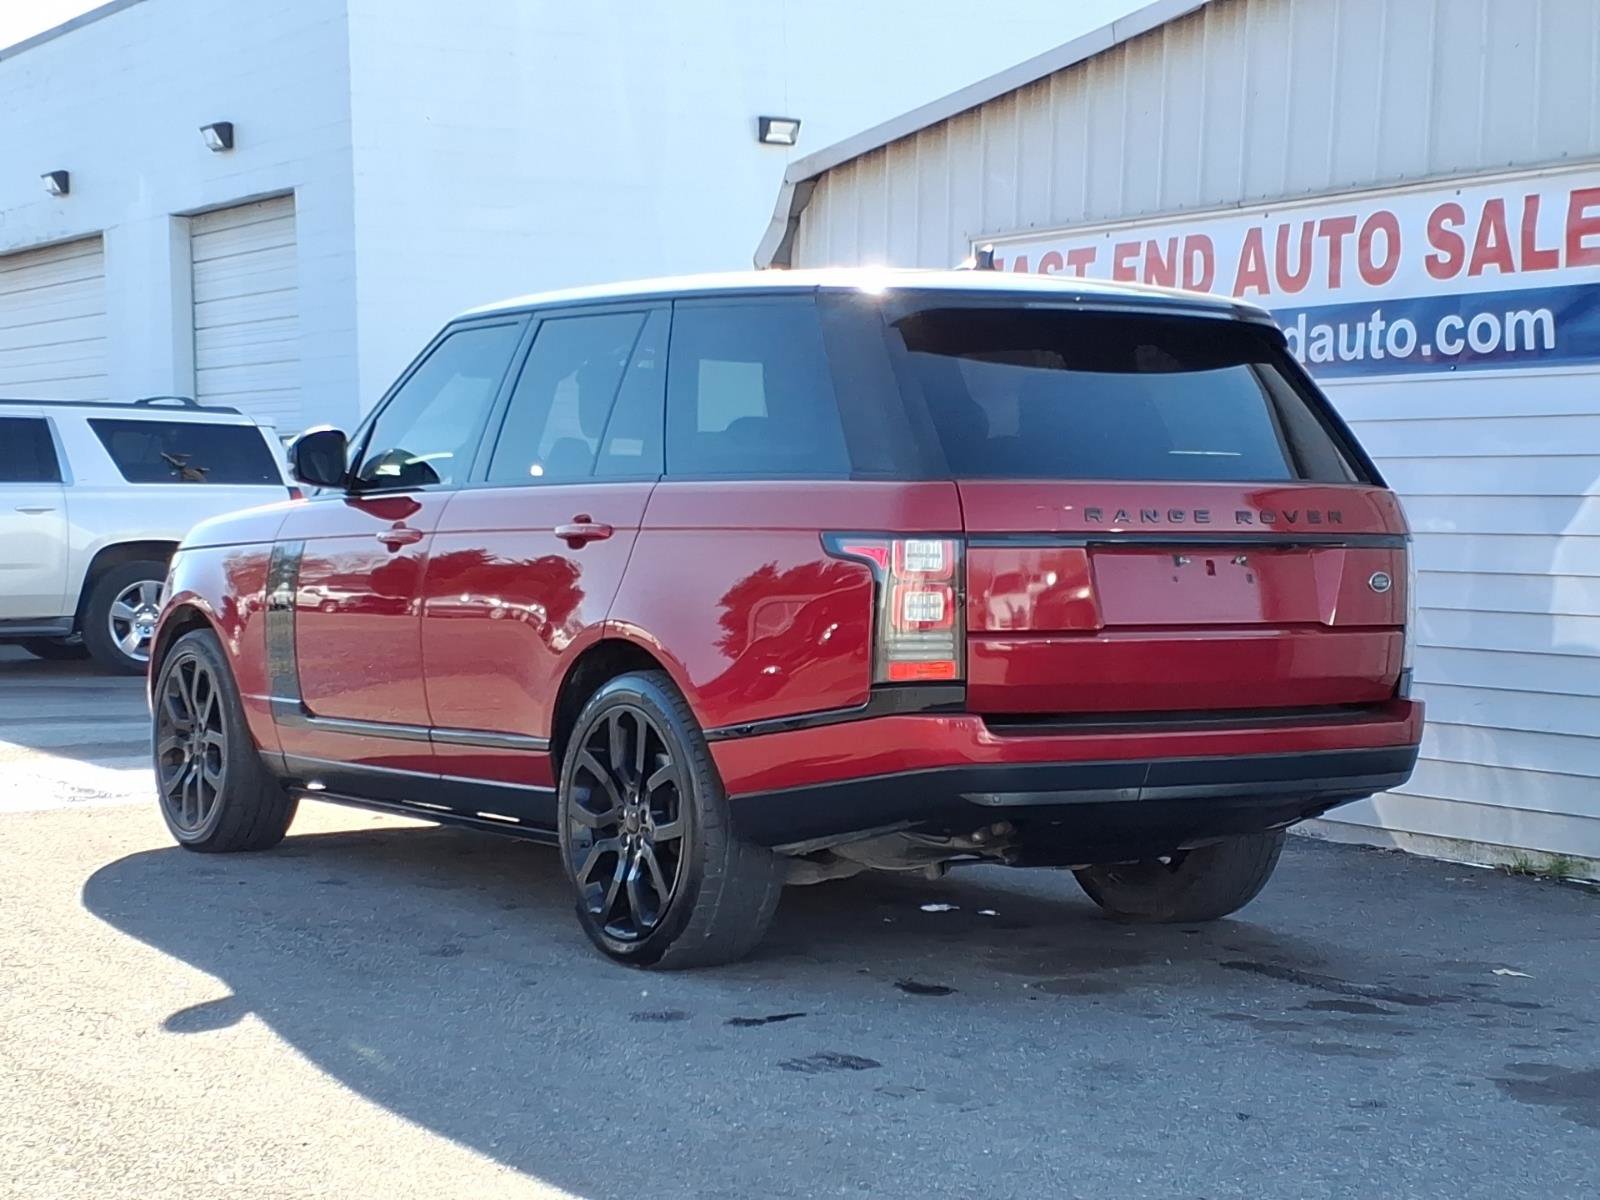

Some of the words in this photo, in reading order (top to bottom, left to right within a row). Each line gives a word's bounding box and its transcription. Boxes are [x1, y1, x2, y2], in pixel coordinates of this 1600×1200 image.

[1112, 234, 1215, 294] END
[1232, 209, 1402, 297] AUTO
[1425, 187, 1600, 281] SALE
[1083, 506, 1212, 523] RANGE
[1235, 509, 1344, 525] ROVER
